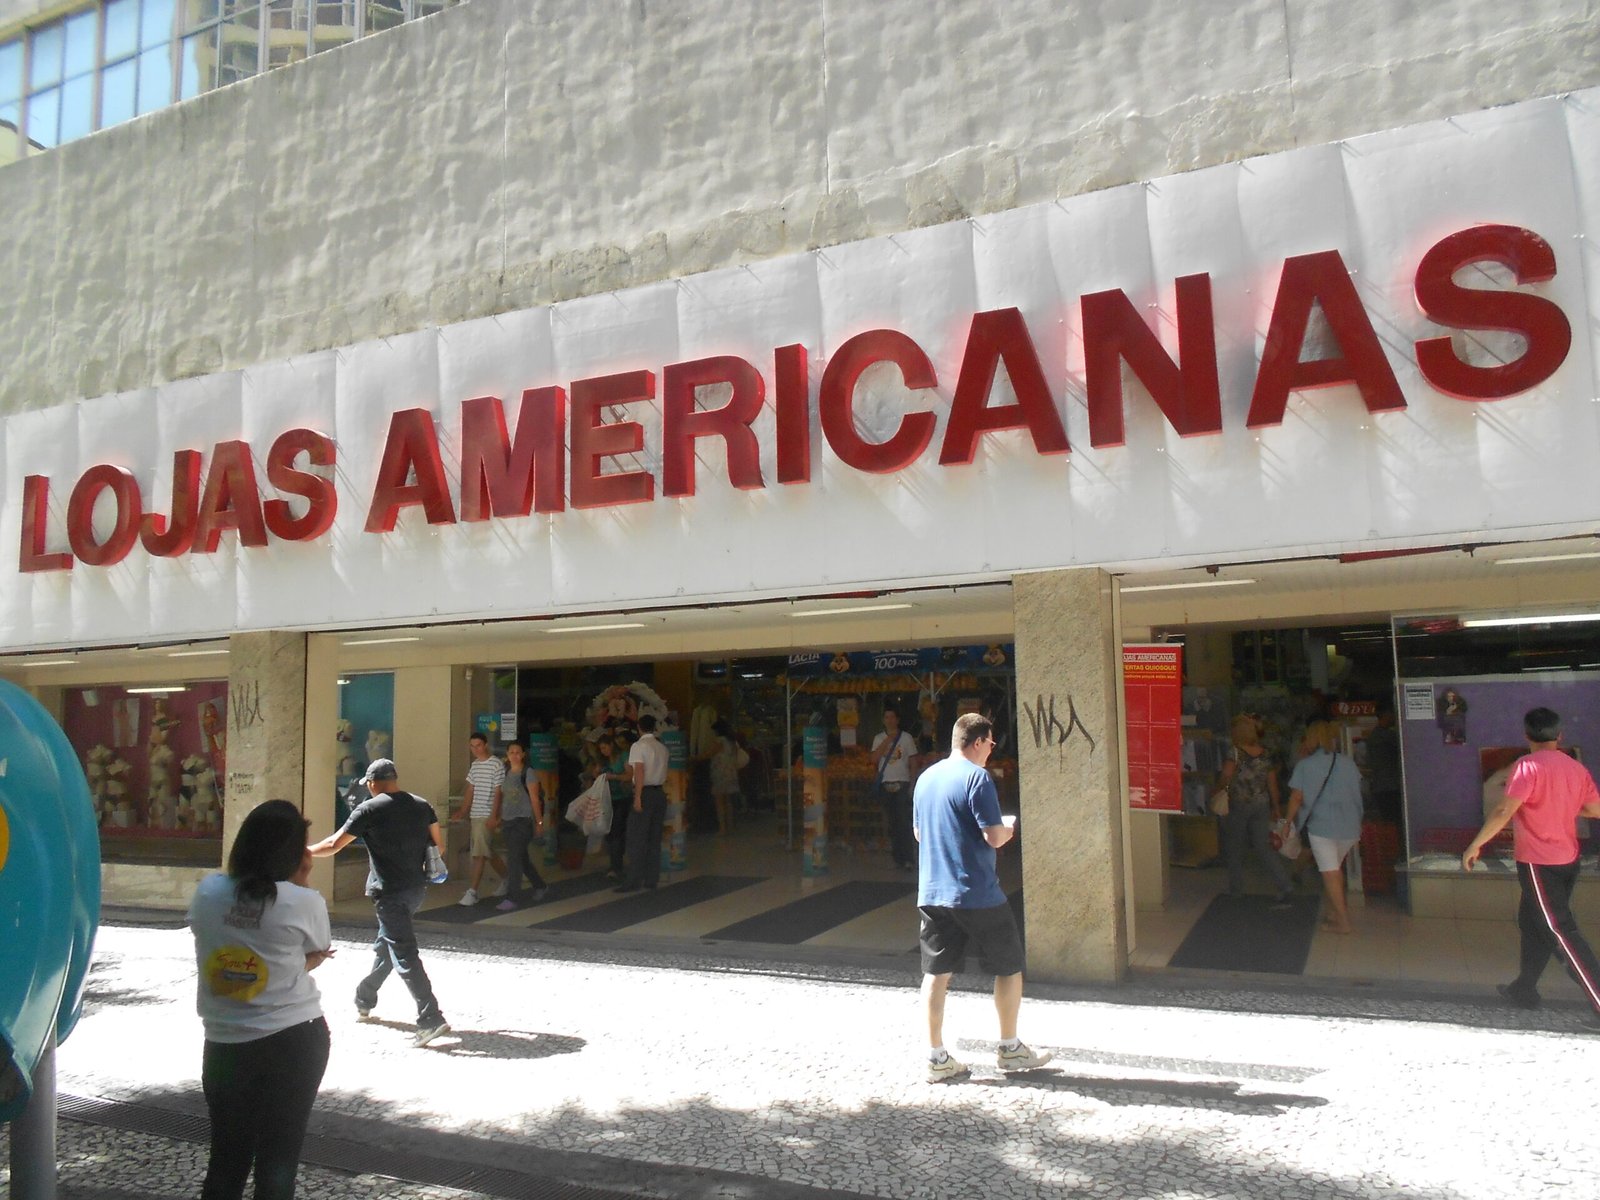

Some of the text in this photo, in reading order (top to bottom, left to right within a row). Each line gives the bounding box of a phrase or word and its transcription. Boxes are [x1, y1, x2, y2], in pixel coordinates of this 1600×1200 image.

[19, 223, 1572, 573] LOJAS AMERICANAS
[788, 653, 820, 665] LACTA
[874, 658, 917, 670] 100 ANOS
